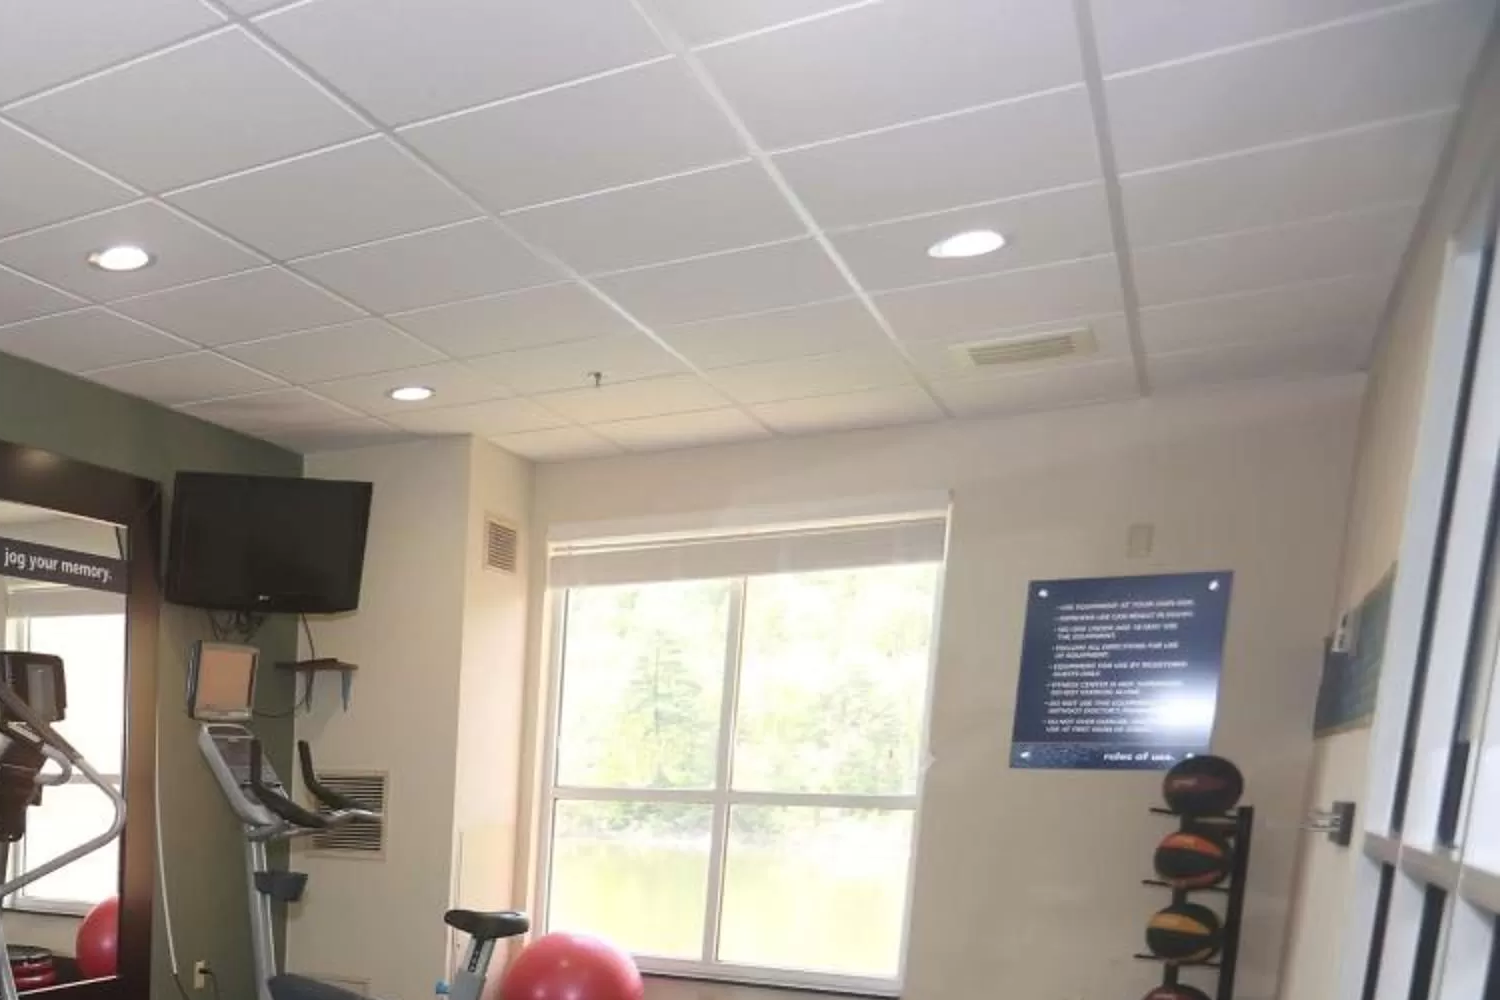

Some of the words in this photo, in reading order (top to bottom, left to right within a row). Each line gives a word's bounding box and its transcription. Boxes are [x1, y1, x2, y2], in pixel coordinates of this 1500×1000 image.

[3, 548, 26, 569] jog
[28, 555, 58, 571] your
[61, 561, 113, 583] memory.
[1103, 751, 1133, 761] rules
[1135, 751, 1149, 761] of
